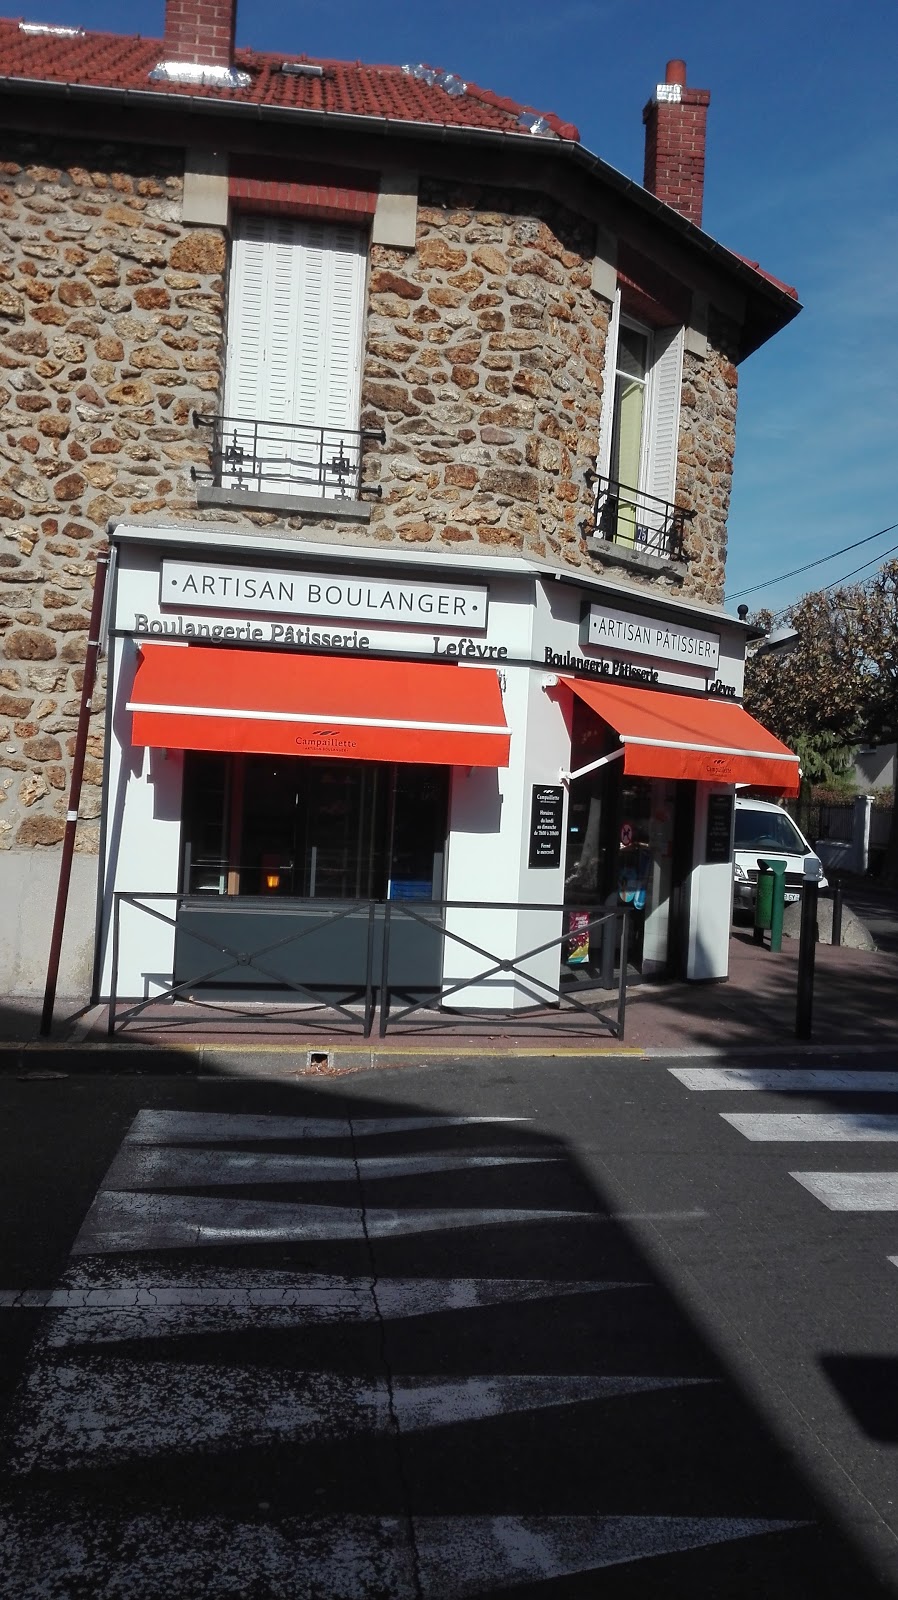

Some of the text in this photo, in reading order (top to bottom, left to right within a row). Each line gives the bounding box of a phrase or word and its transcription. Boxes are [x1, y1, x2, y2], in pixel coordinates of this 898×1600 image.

[638, 526, 646, 541] 75
[182, 574, 467, 615] ARTISAN BOULANGER
[134, 613, 508, 659] Boulangerie Pâtisserie Lefèvre
[598, 617, 711, 658] ARTISAN PÂTISSIER
[544, 646, 610, 674] Boulangerie
[613, 659, 659, 682] Pâtisserie
[295, 736, 357, 748] Campaillette
